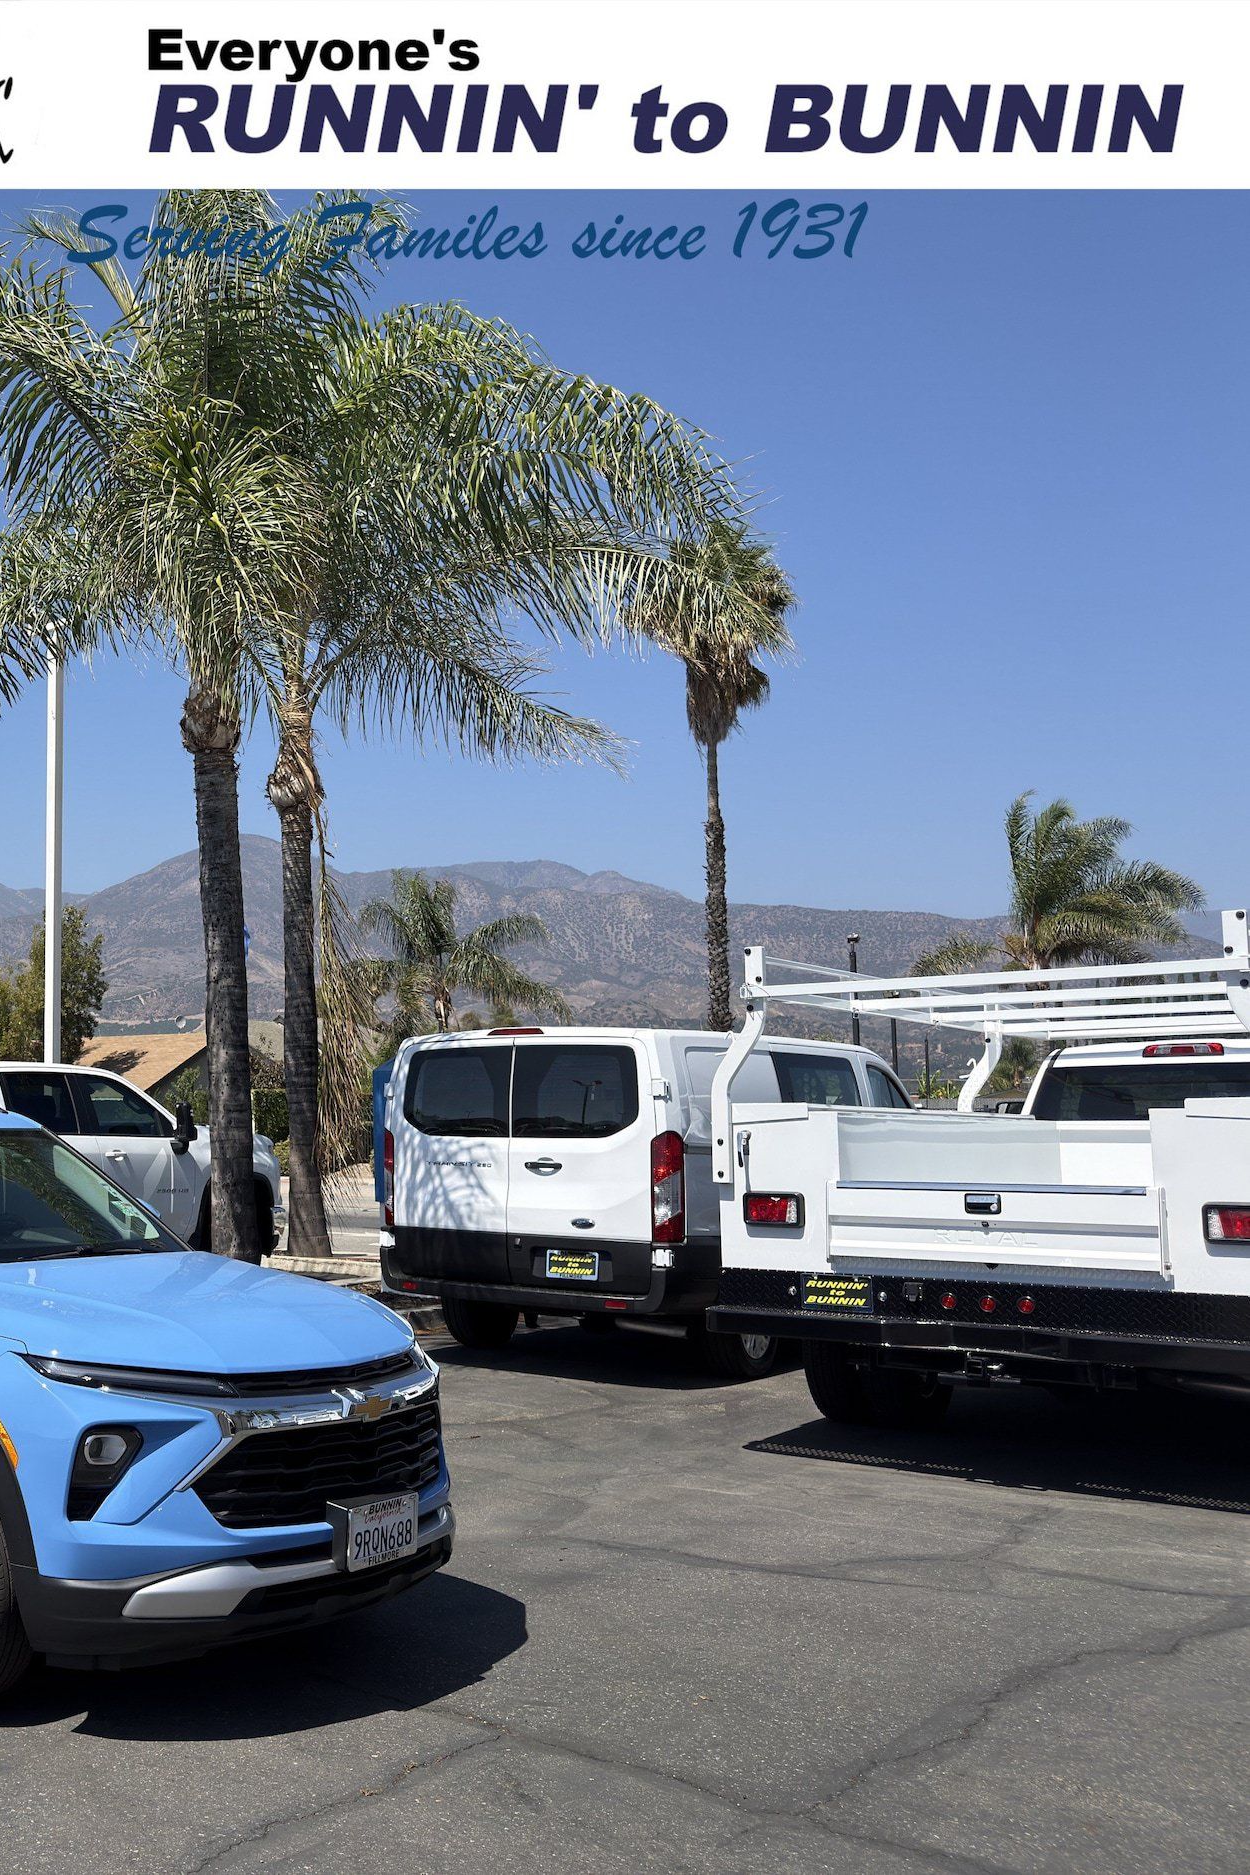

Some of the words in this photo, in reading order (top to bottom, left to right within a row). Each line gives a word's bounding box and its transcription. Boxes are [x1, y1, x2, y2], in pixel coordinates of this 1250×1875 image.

[549, 1266, 594, 1275] BUNNIN
[806, 1280, 869, 1290] RUNNIN'
[806, 1295, 867, 1306] BUNNIN
[368, 1498, 403, 1515] BUNNIN
[354, 1518, 412, 1561] 9RQN688
[368, 1549, 400, 1566] FILLMORE
